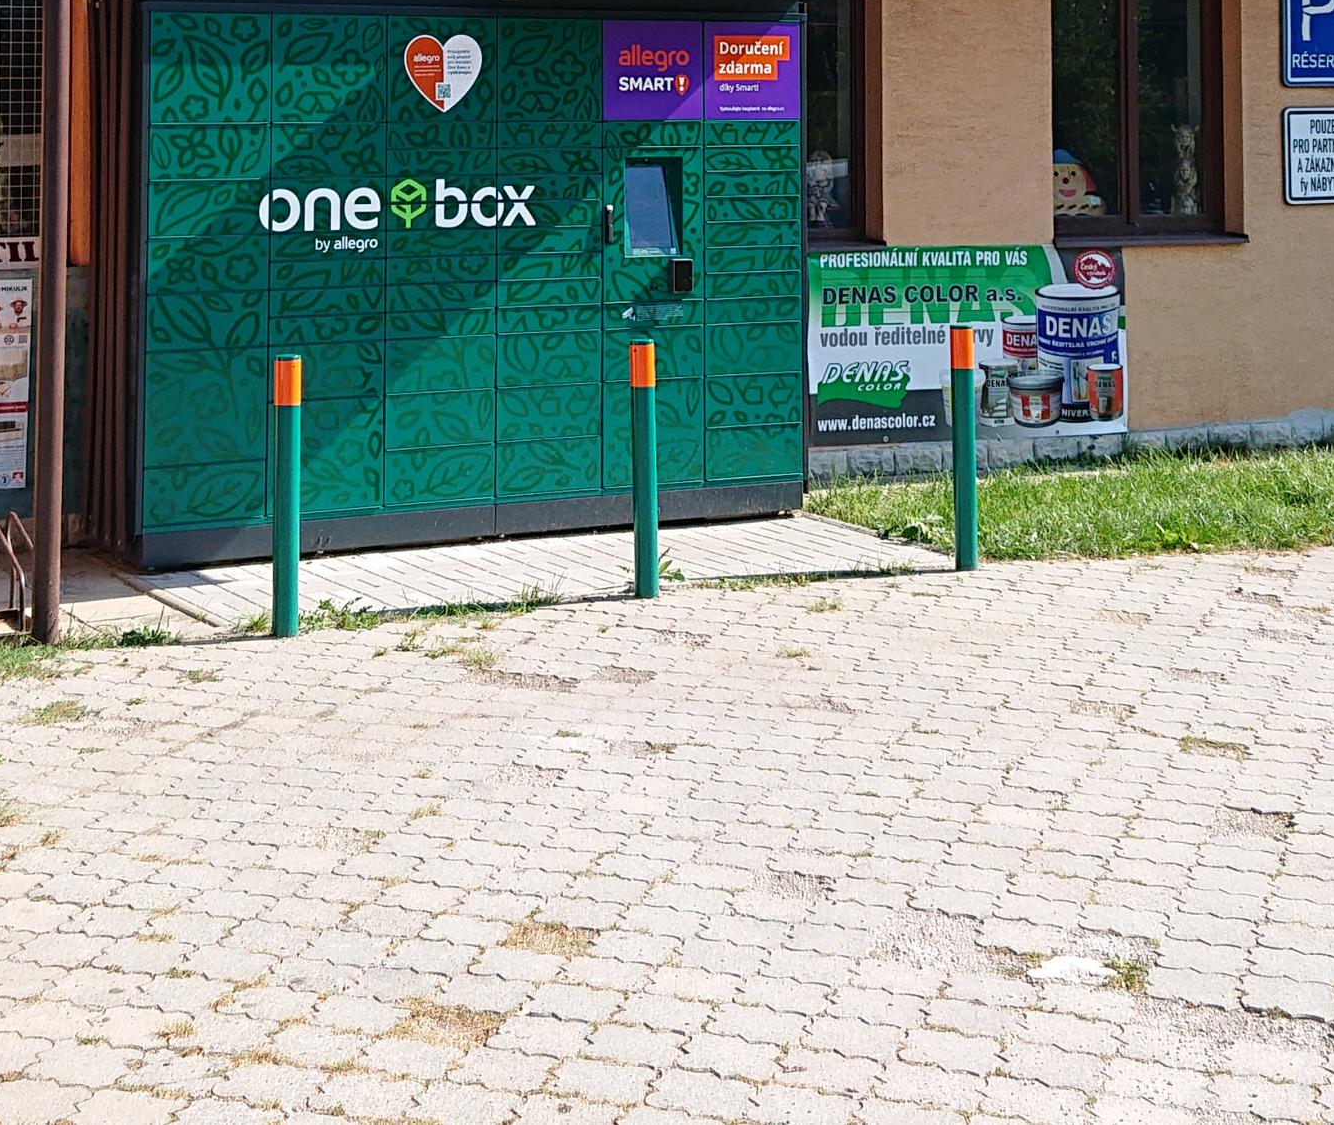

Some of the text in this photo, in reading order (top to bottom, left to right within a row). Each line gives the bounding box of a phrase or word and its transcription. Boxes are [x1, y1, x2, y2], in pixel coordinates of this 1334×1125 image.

[719, 40, 783, 56] Doručení
[413, 53, 440, 64] allegro
[618, 44, 689, 72] allegro
[718, 61, 772, 74] zdarma
[1293, 139, 1310, 153] PRO
[1297, 160, 1303, 173] A
[1300, 179, 1308, 196] fy
[259, 178, 537, 232] one box
[315, 236, 378, 253] by allegro
[819, 248, 1028, 268] PROFESIONÁLNÍ KVALITA PRO VÁS
[823, 285, 1022, 305] DENAS COLOR a.s.
[1045, 314, 1112, 339] DENAS
[820, 326, 994, 347] vodou ředitelné rvy
[1007, 334, 1036, 347] DENA
[821, 360, 910, 384] DENAS
[857, 383, 902, 391] COLOR
[817, 413, 936, 432] www.denascolor.cz
